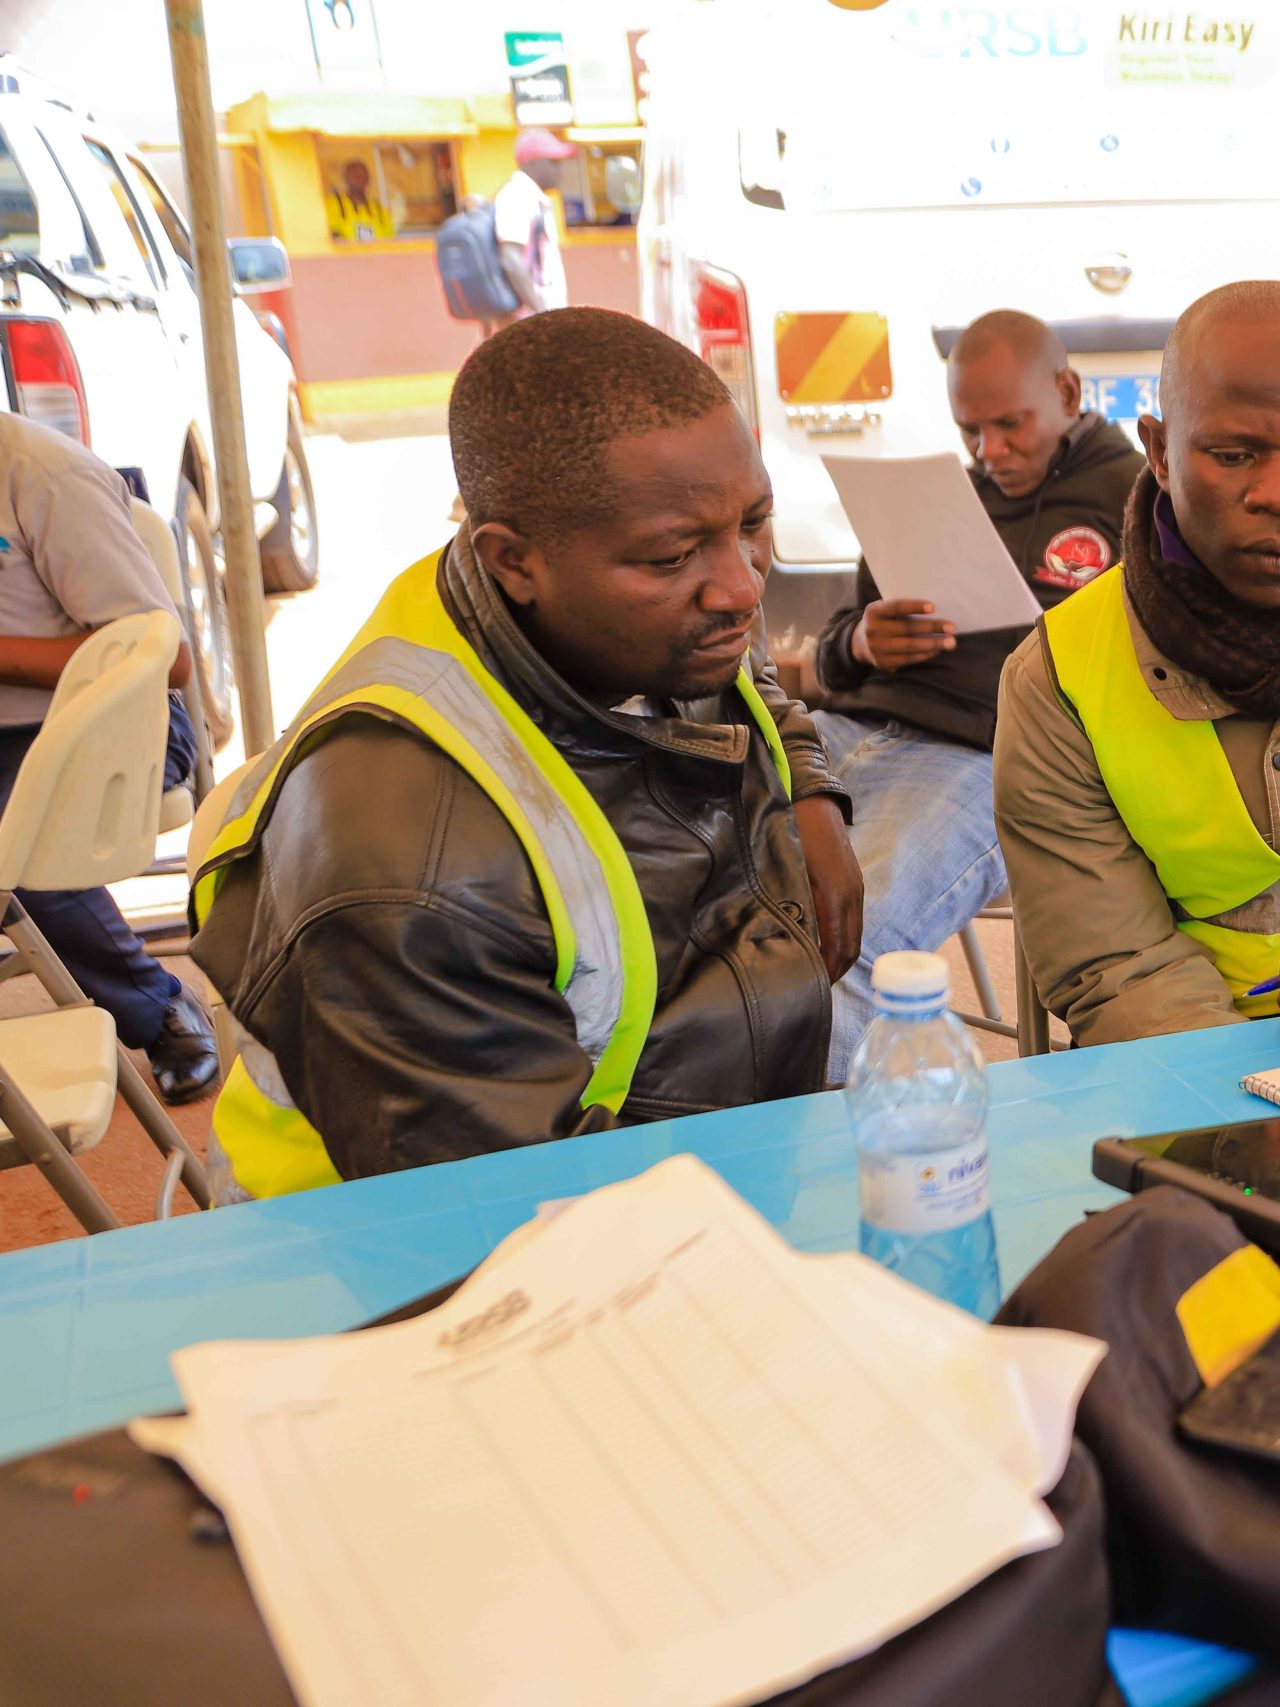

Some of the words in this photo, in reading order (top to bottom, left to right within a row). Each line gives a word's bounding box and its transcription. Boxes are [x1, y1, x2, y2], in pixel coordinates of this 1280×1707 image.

[1118, 11, 1174, 42] Kiri
[1183, 12, 1256, 52] Easy
[1134, 378, 1161, 416] 3
